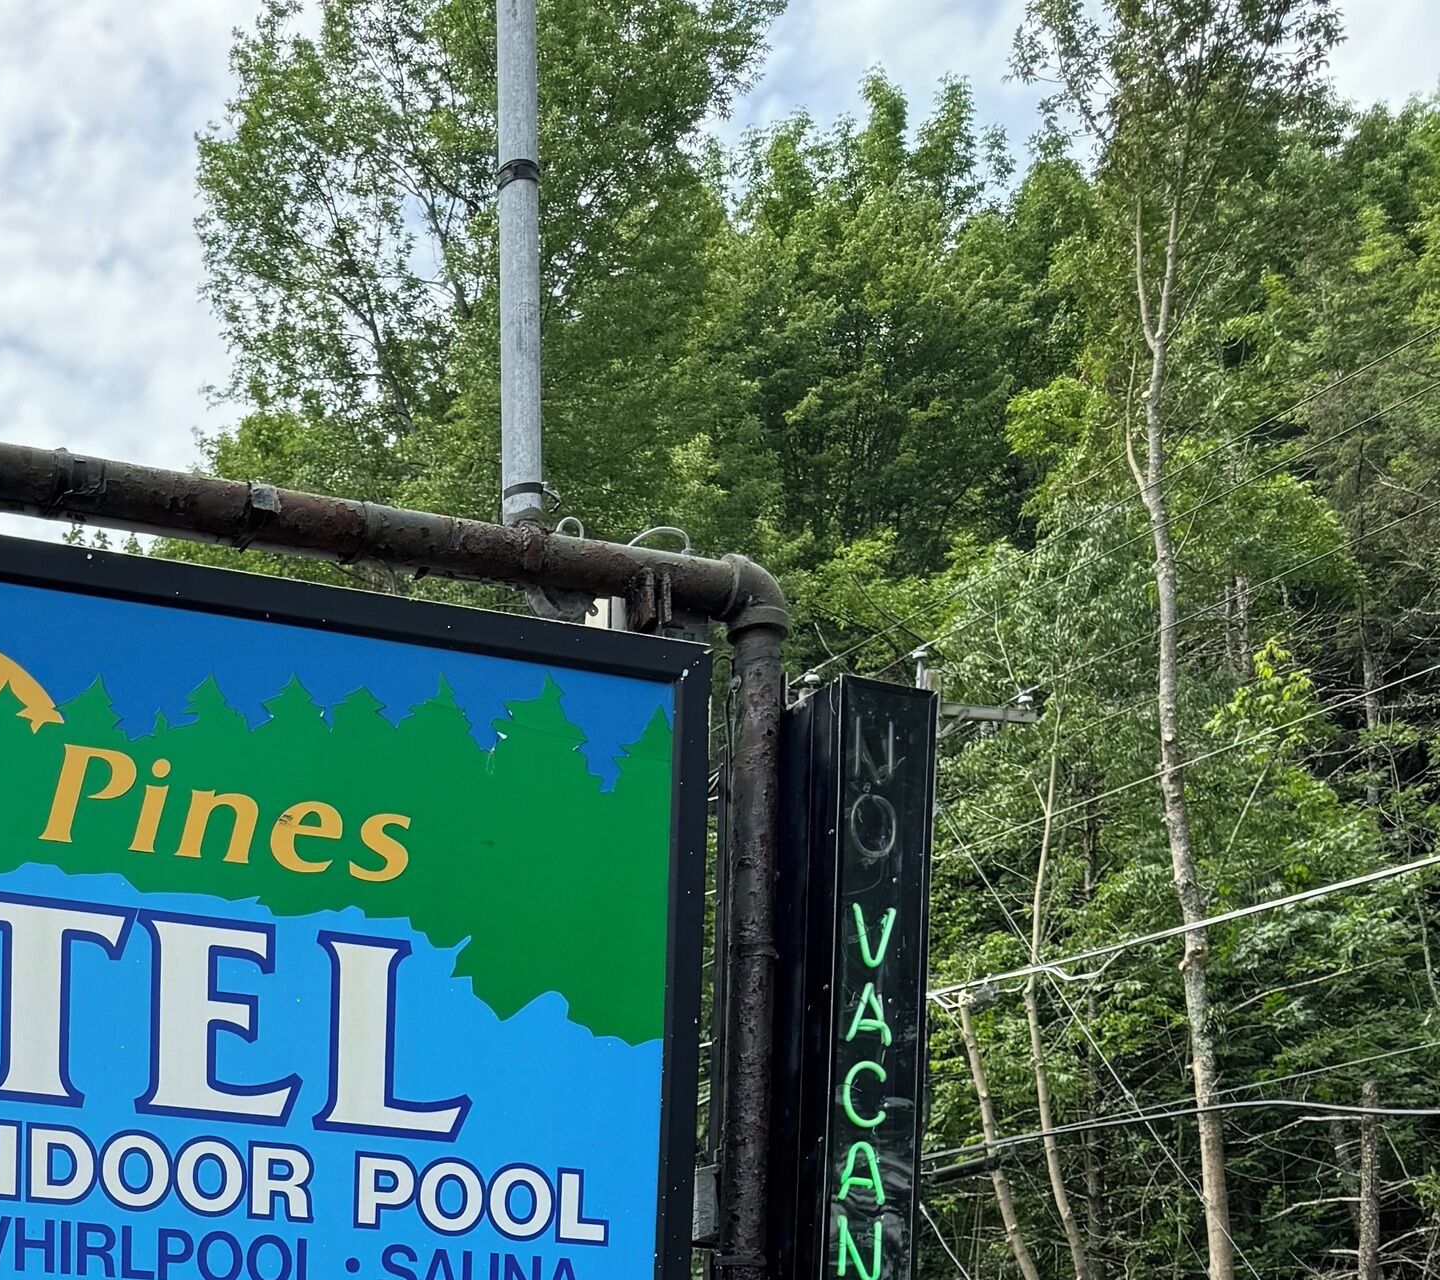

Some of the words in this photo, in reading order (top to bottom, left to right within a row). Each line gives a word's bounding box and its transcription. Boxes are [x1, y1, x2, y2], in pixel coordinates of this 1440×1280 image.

[38, 742, 412, 885] Pines
[850, 714, 898, 859] NO
[355, 1148, 609, 1248] POOL
